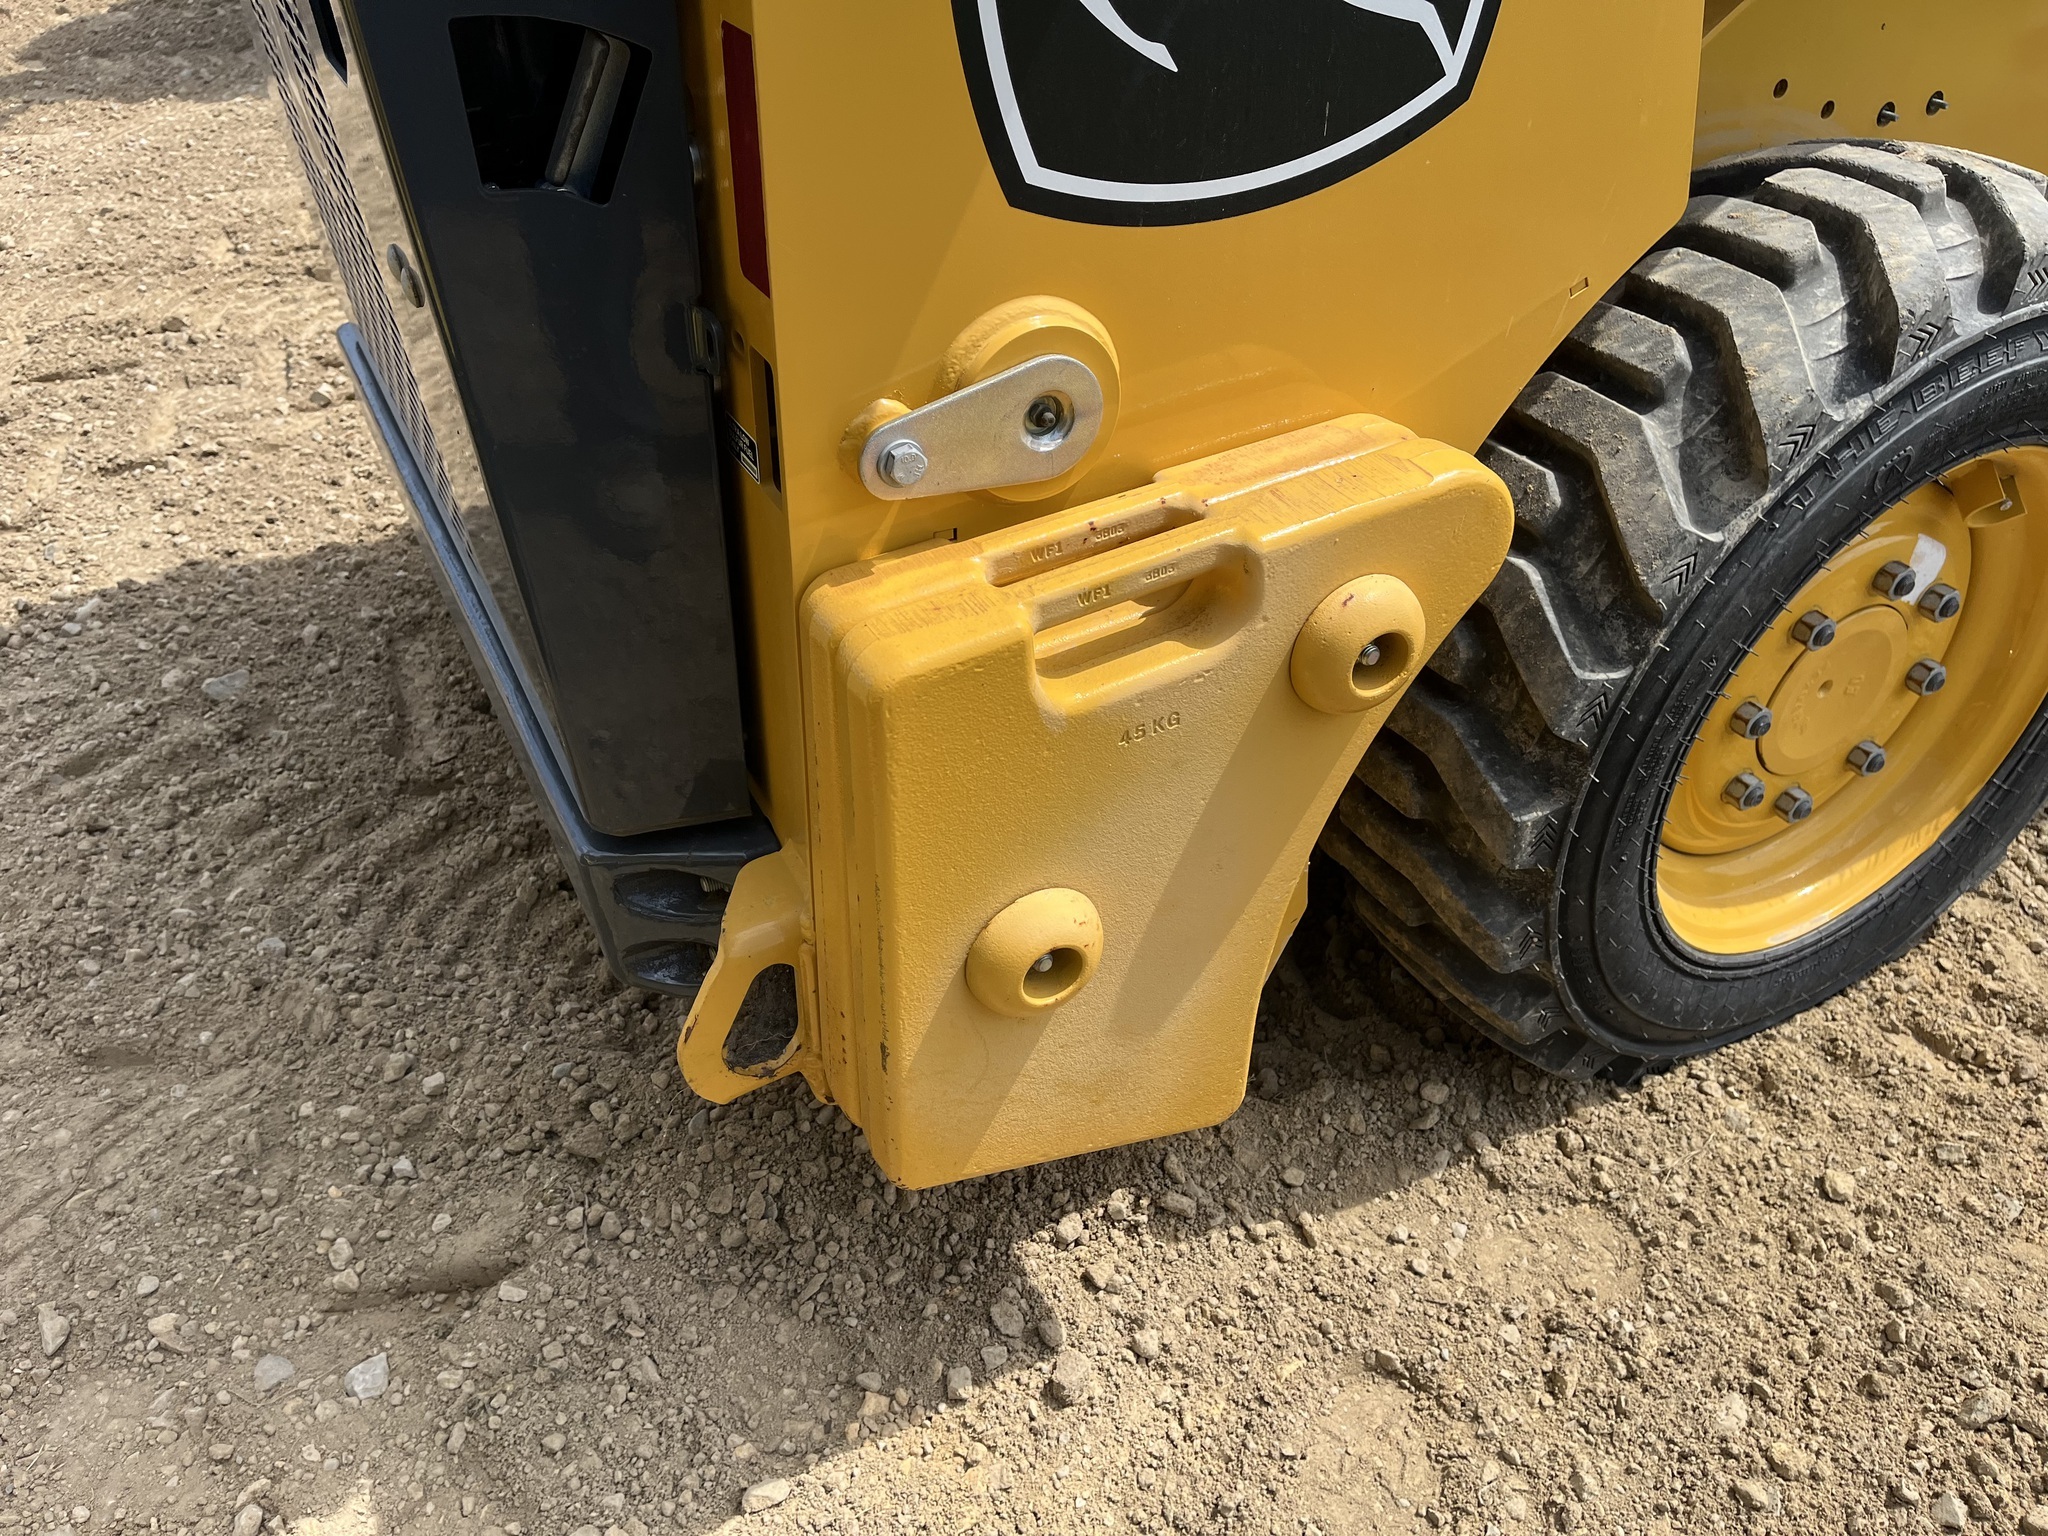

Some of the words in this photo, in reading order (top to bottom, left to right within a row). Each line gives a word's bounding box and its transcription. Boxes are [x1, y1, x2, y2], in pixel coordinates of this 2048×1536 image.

[1784, 408, 1899, 507] THE
[1030, 541, 1063, 563] WF1
[1077, 584, 1111, 607] WF1
[1118, 723, 1146, 747] 45
[1151, 711, 1181, 736] KG
